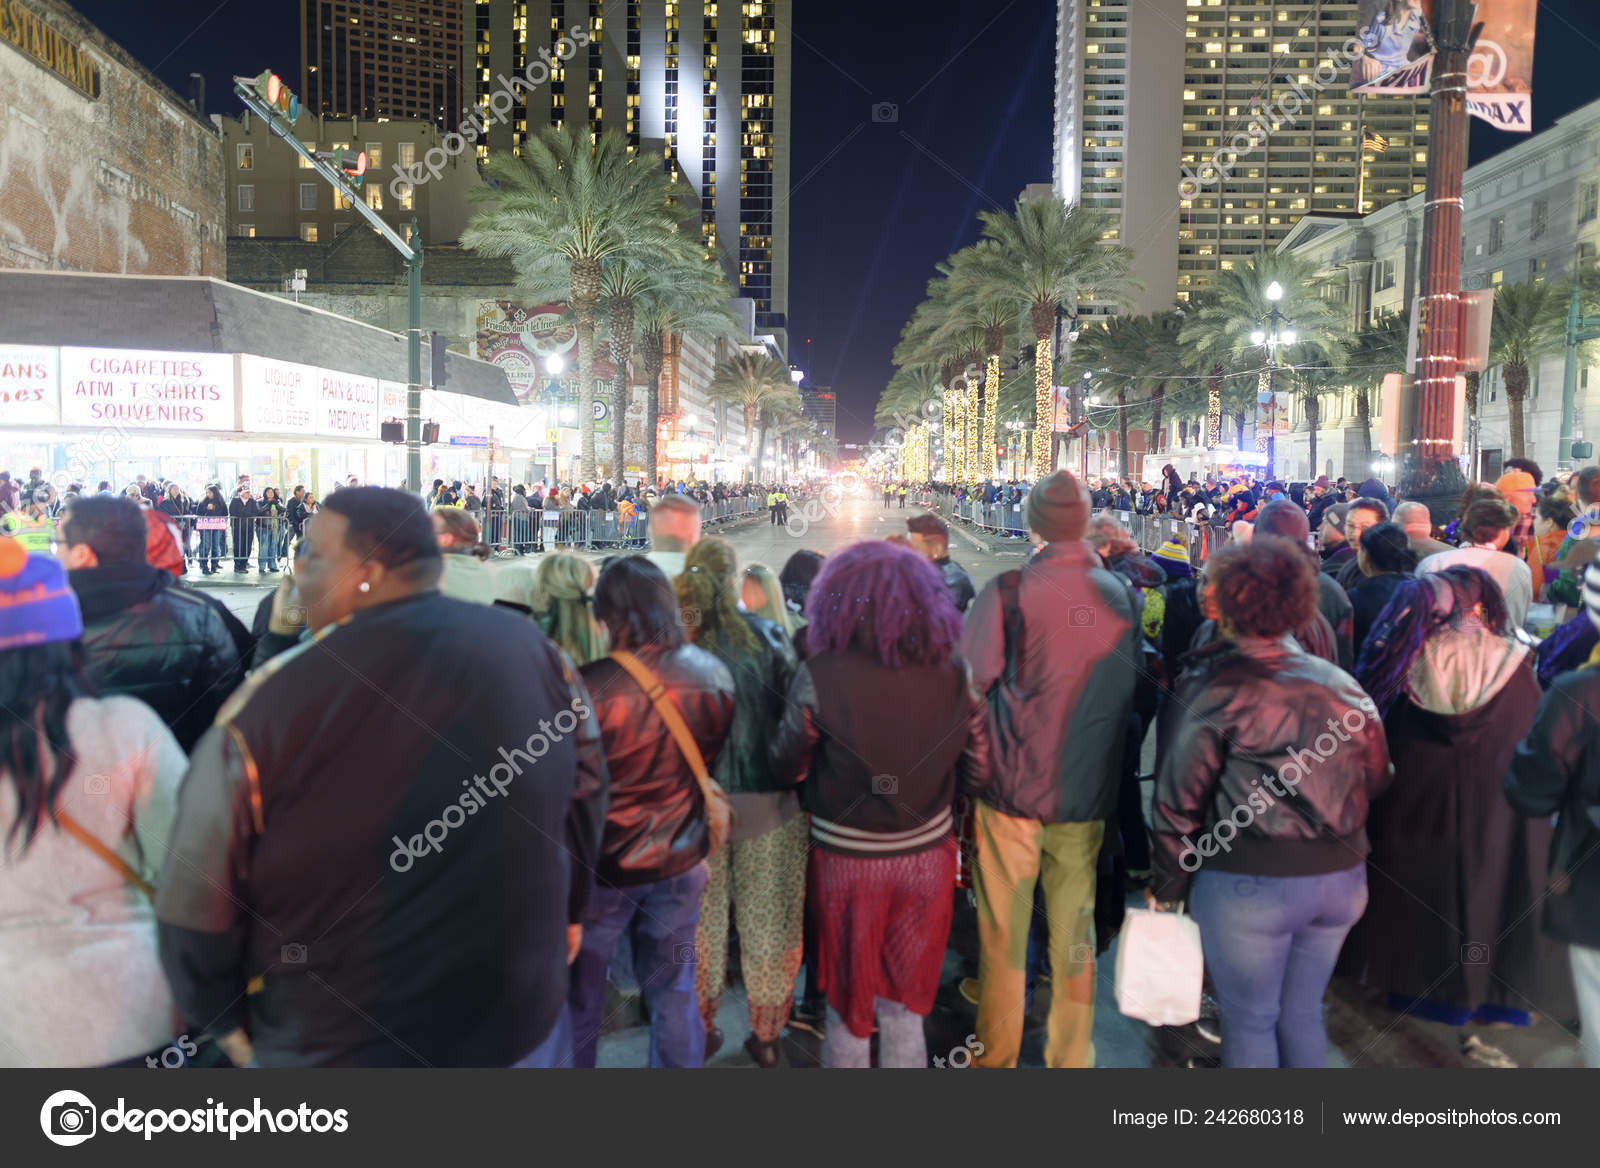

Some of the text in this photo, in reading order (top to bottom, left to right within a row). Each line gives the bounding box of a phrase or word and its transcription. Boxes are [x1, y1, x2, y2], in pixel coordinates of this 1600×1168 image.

[485, 316, 511, 333] Friends
[90, 357, 203, 378] CIGARETTES
[265, 367, 301, 388] LIQUOR
[75, 380, 113, 398] ATM
[272, 388, 295, 407] WINE
[322, 377, 344, 401] PAIN
[346, 385, 353, 401] &
[355, 383, 375, 405] COLD
[91, 402, 204, 422] SOUVENIRS
[256, 406, 310, 427] COLD BEER
[328, 408, 370, 432] MEDICINE
